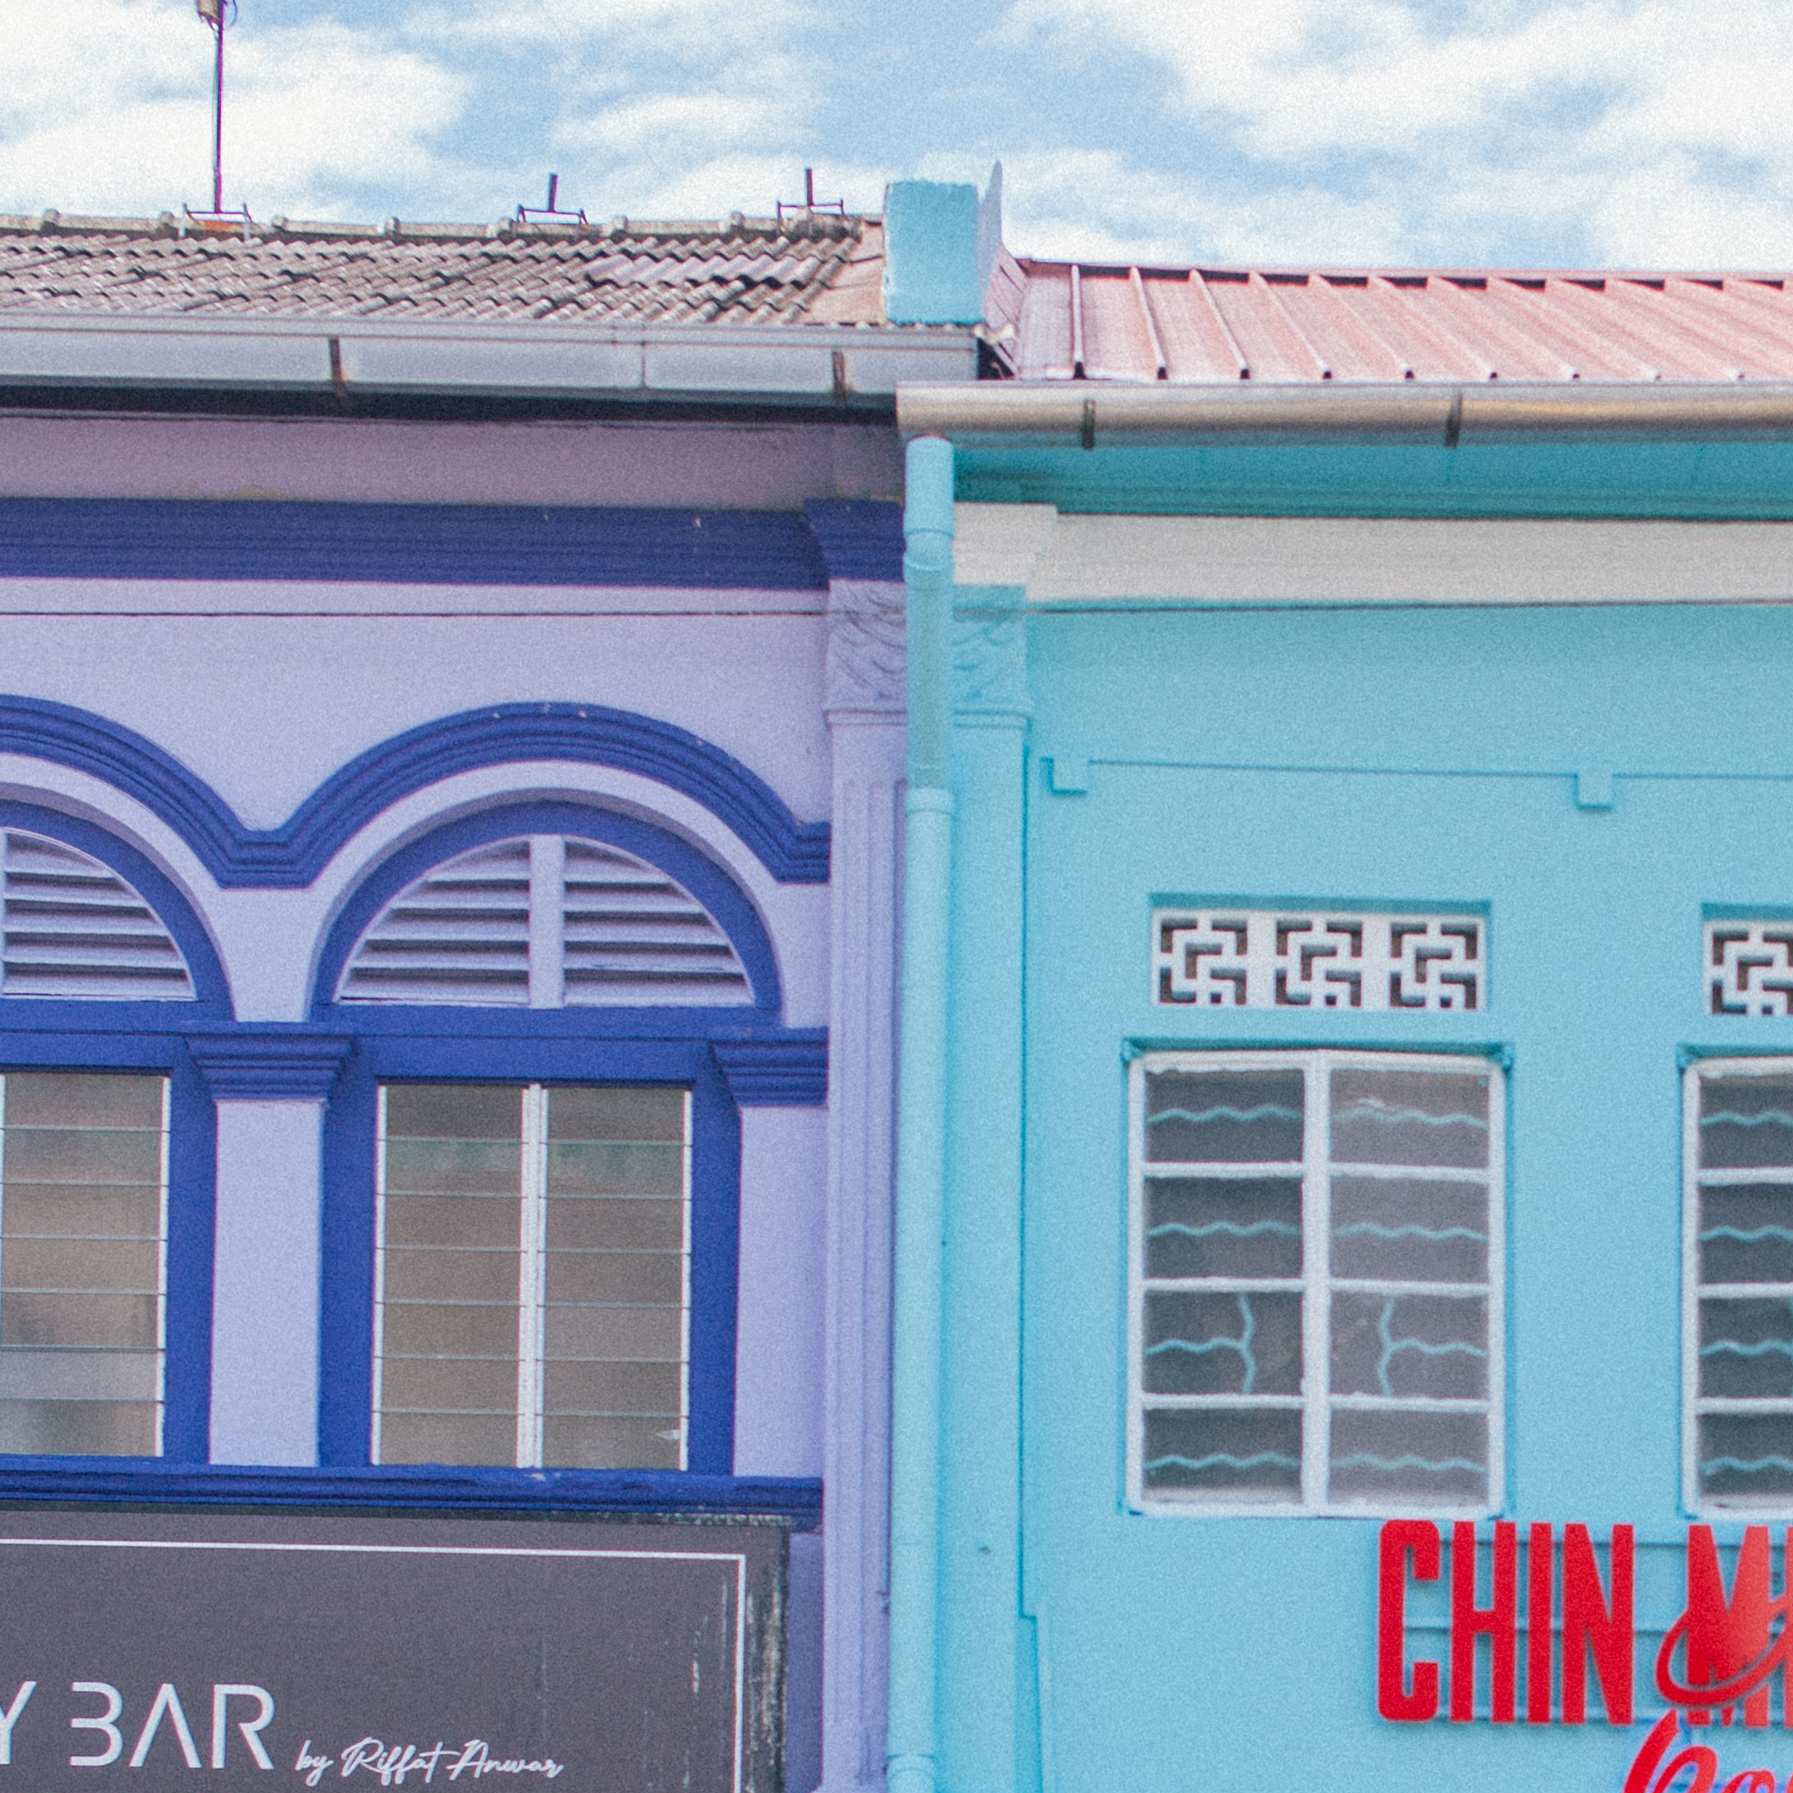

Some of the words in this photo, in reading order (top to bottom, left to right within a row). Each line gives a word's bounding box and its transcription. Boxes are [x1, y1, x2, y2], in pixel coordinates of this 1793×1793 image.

[1379, 1520, 1634, 1726] CHIN
[70, 1681, 275, 1770] BAR
[295, 1739, 334, 1787] by
[341, 1737, 460, 1786] Riffat
[447, 1739, 564, 1781] Anwar
